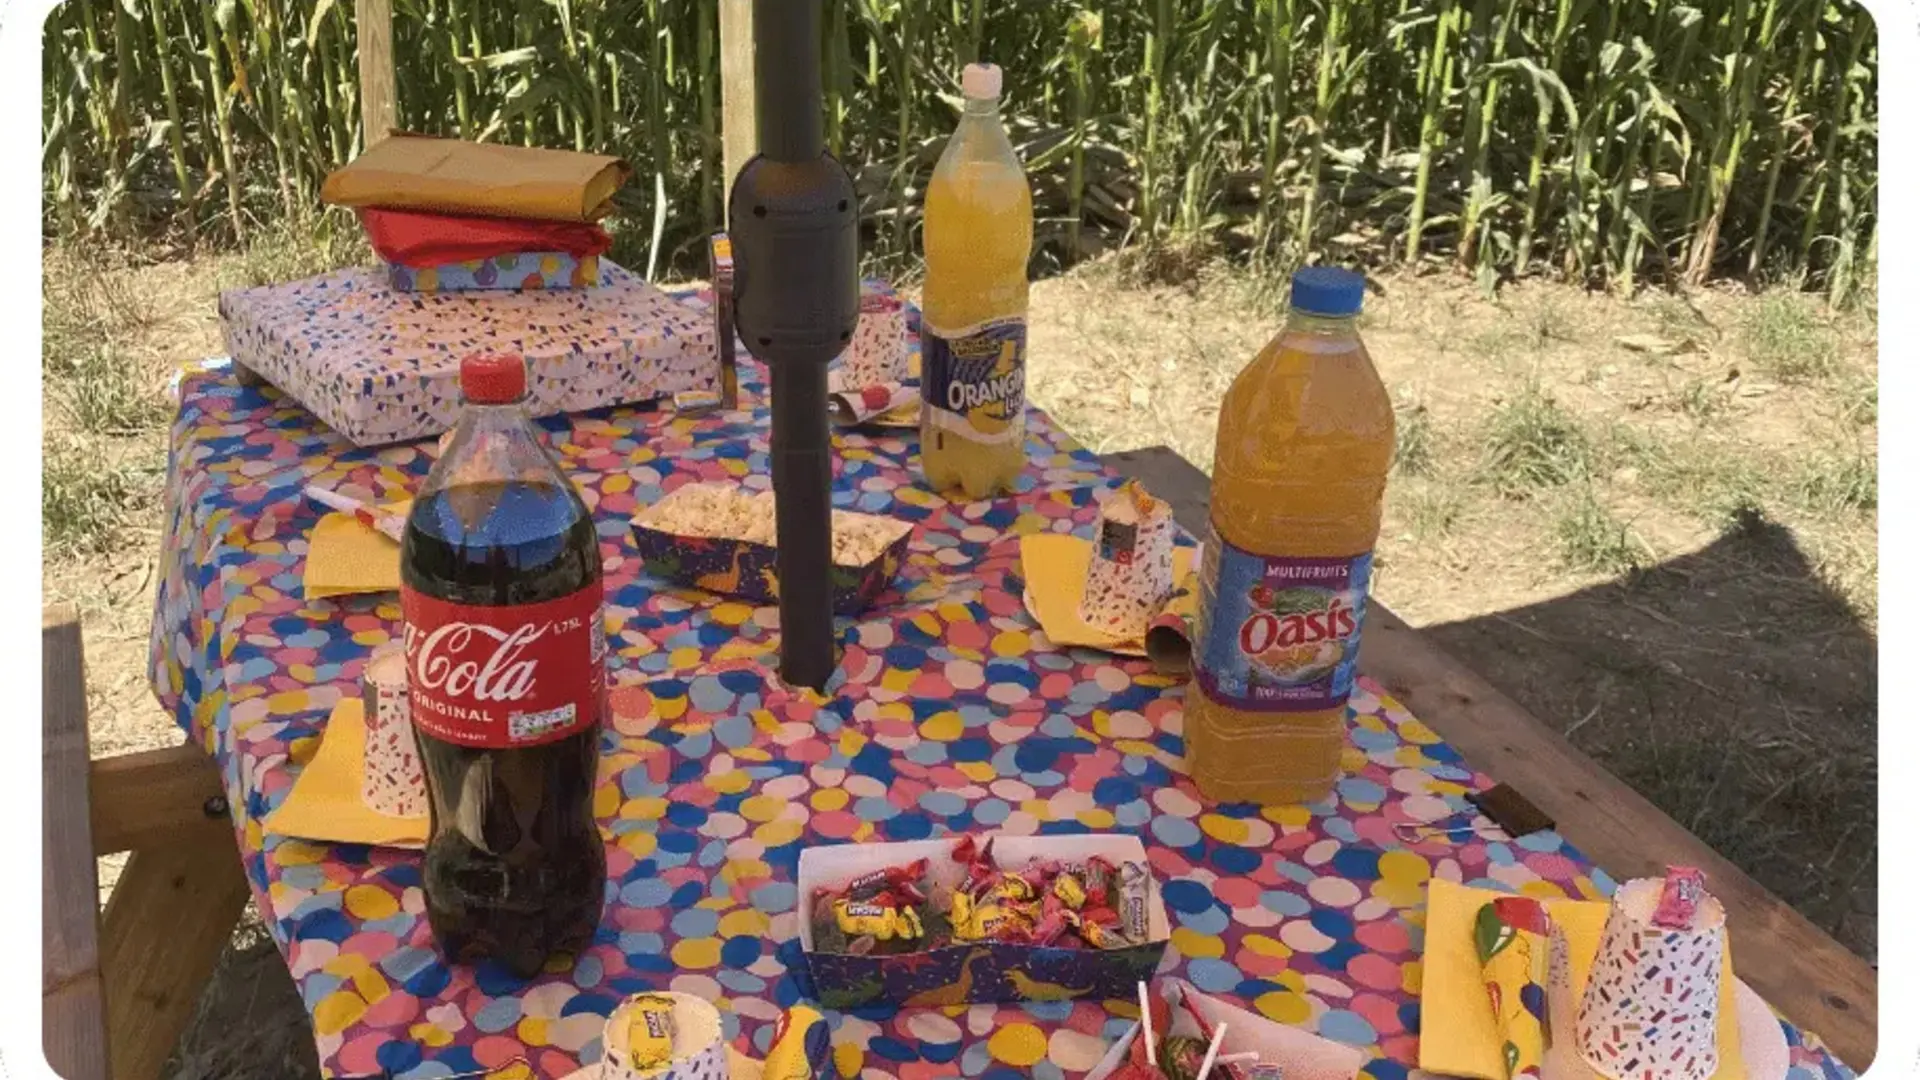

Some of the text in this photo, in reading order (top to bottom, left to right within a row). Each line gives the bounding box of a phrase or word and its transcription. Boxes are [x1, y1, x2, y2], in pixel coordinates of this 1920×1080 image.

[1265, 564, 1348, 578] MULTIFRUITS
[1240, 598, 1356, 654] Oasis
[412, 691, 494, 722] ORIGINAL
